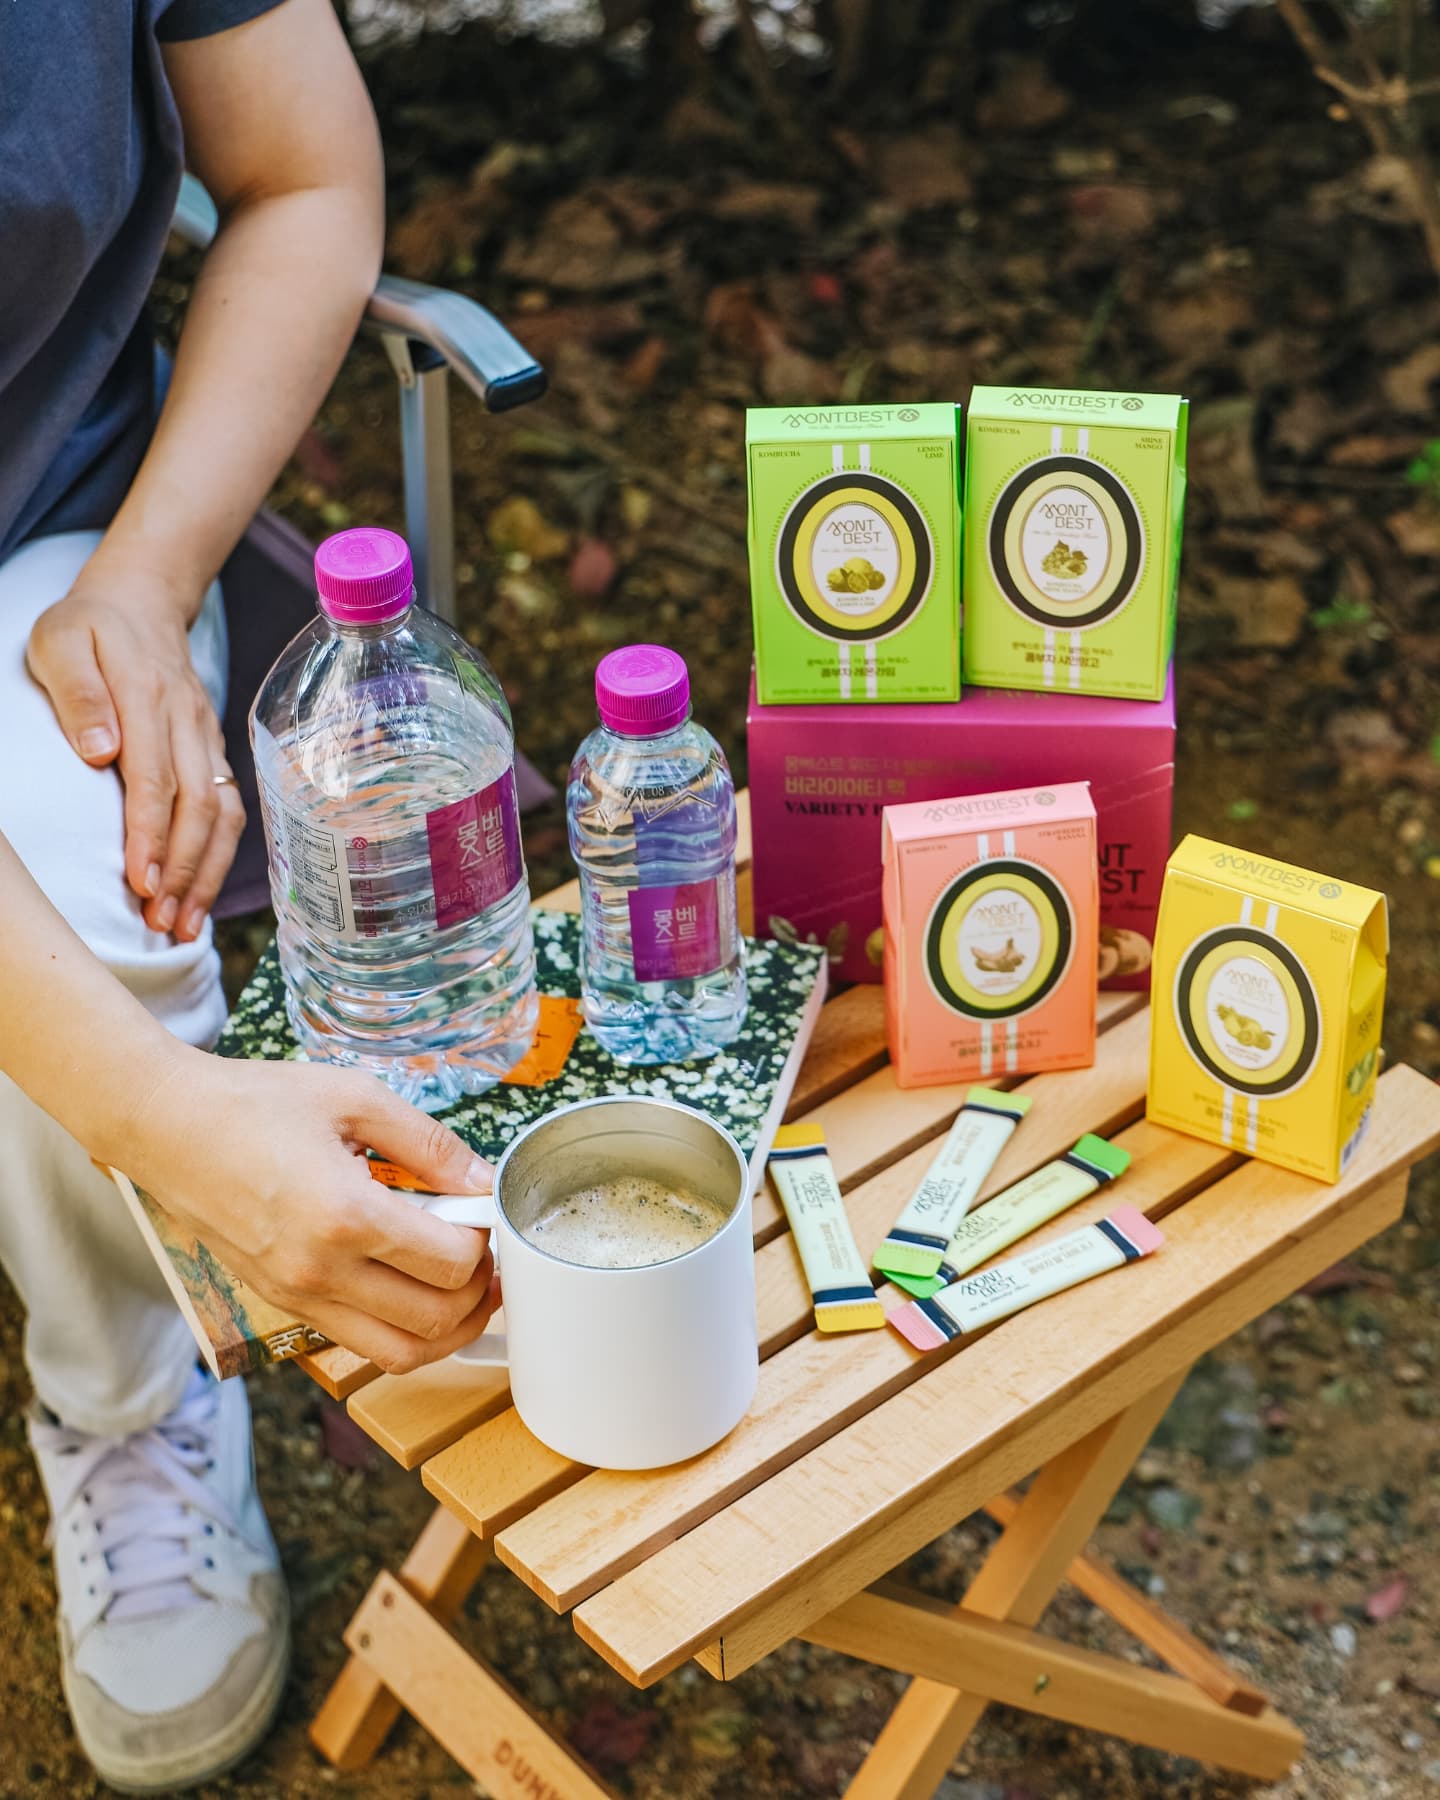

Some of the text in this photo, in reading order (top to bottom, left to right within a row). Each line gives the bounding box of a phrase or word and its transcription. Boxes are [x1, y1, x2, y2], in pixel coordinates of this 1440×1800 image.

[1005, 392, 1120, 407] MONTBEST
[781, 410, 895, 429] MONTBEST
[1039, 502, 1088, 521] MONT
[826, 519, 876, 536] MONT
[1055, 516, 1094, 530] BEST
[843, 531, 881, 544] BEST
[785, 801, 867, 816] VARIETY
[961, 1269, 1004, 1296] MONT
